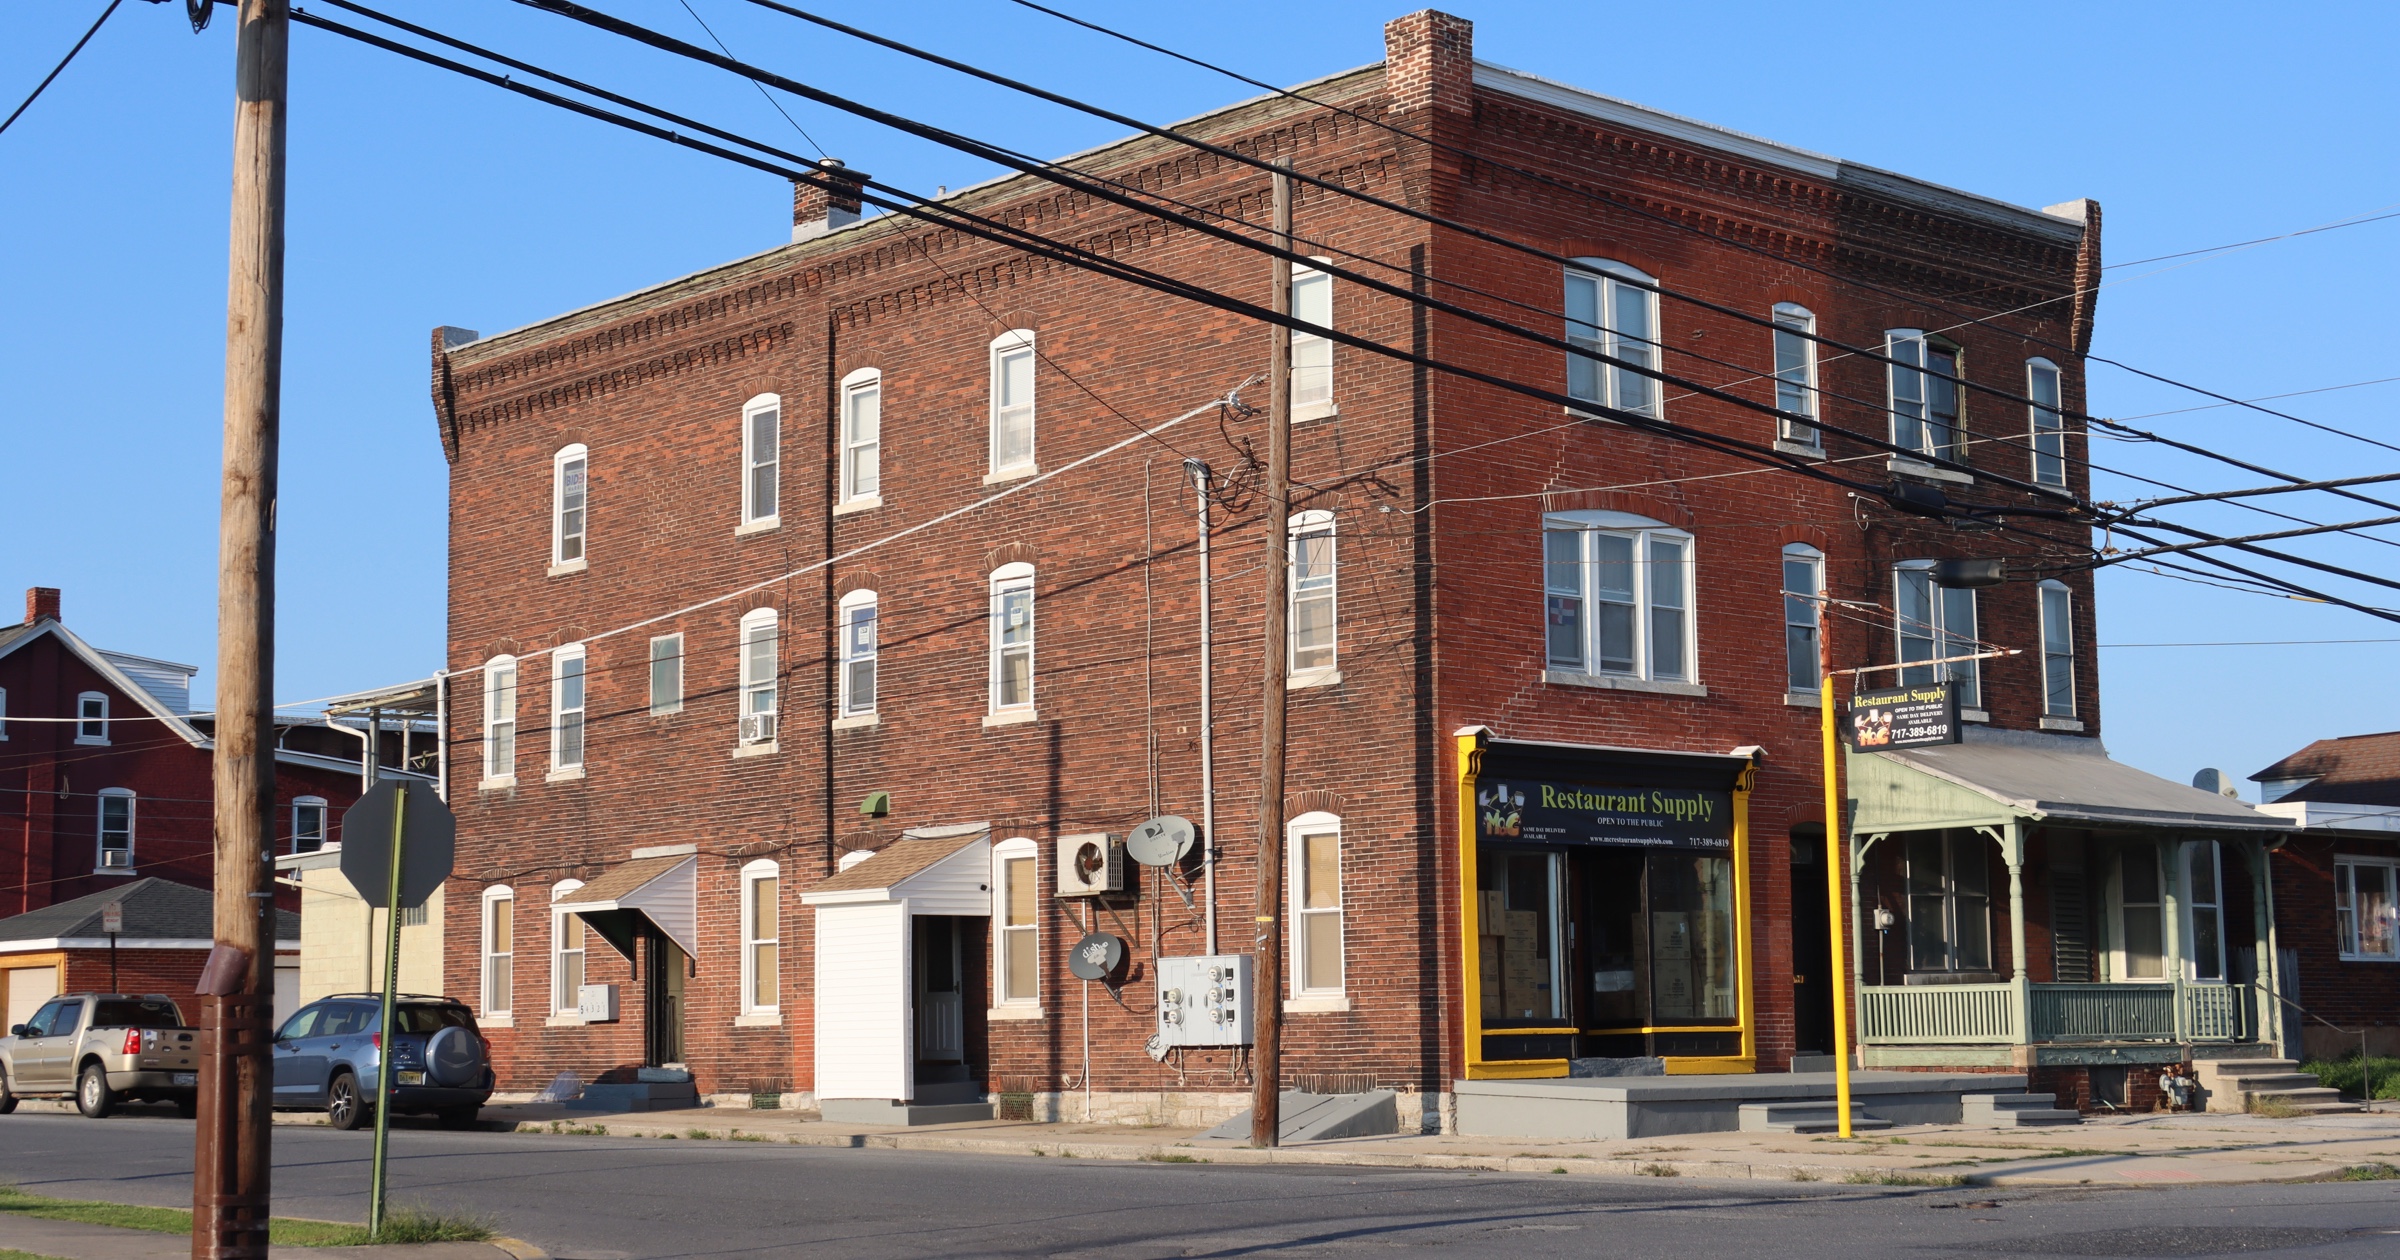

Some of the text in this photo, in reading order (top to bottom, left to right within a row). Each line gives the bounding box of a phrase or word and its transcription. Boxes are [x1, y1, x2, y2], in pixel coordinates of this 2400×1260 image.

[1854, 687, 1946, 708] Restaurant Supply
[1919, 710, 1943, 718] DELIVERY
[1891, 724, 1948, 739] 717-389-6819
[1541, 784, 1714, 822] Restaurant Supply
[1597, 817, 1664, 828] OPEN TO THE PUBLIC
[1689, 837, 1730, 847] 717-389-6819
[1082, 942, 1101, 959] dish
